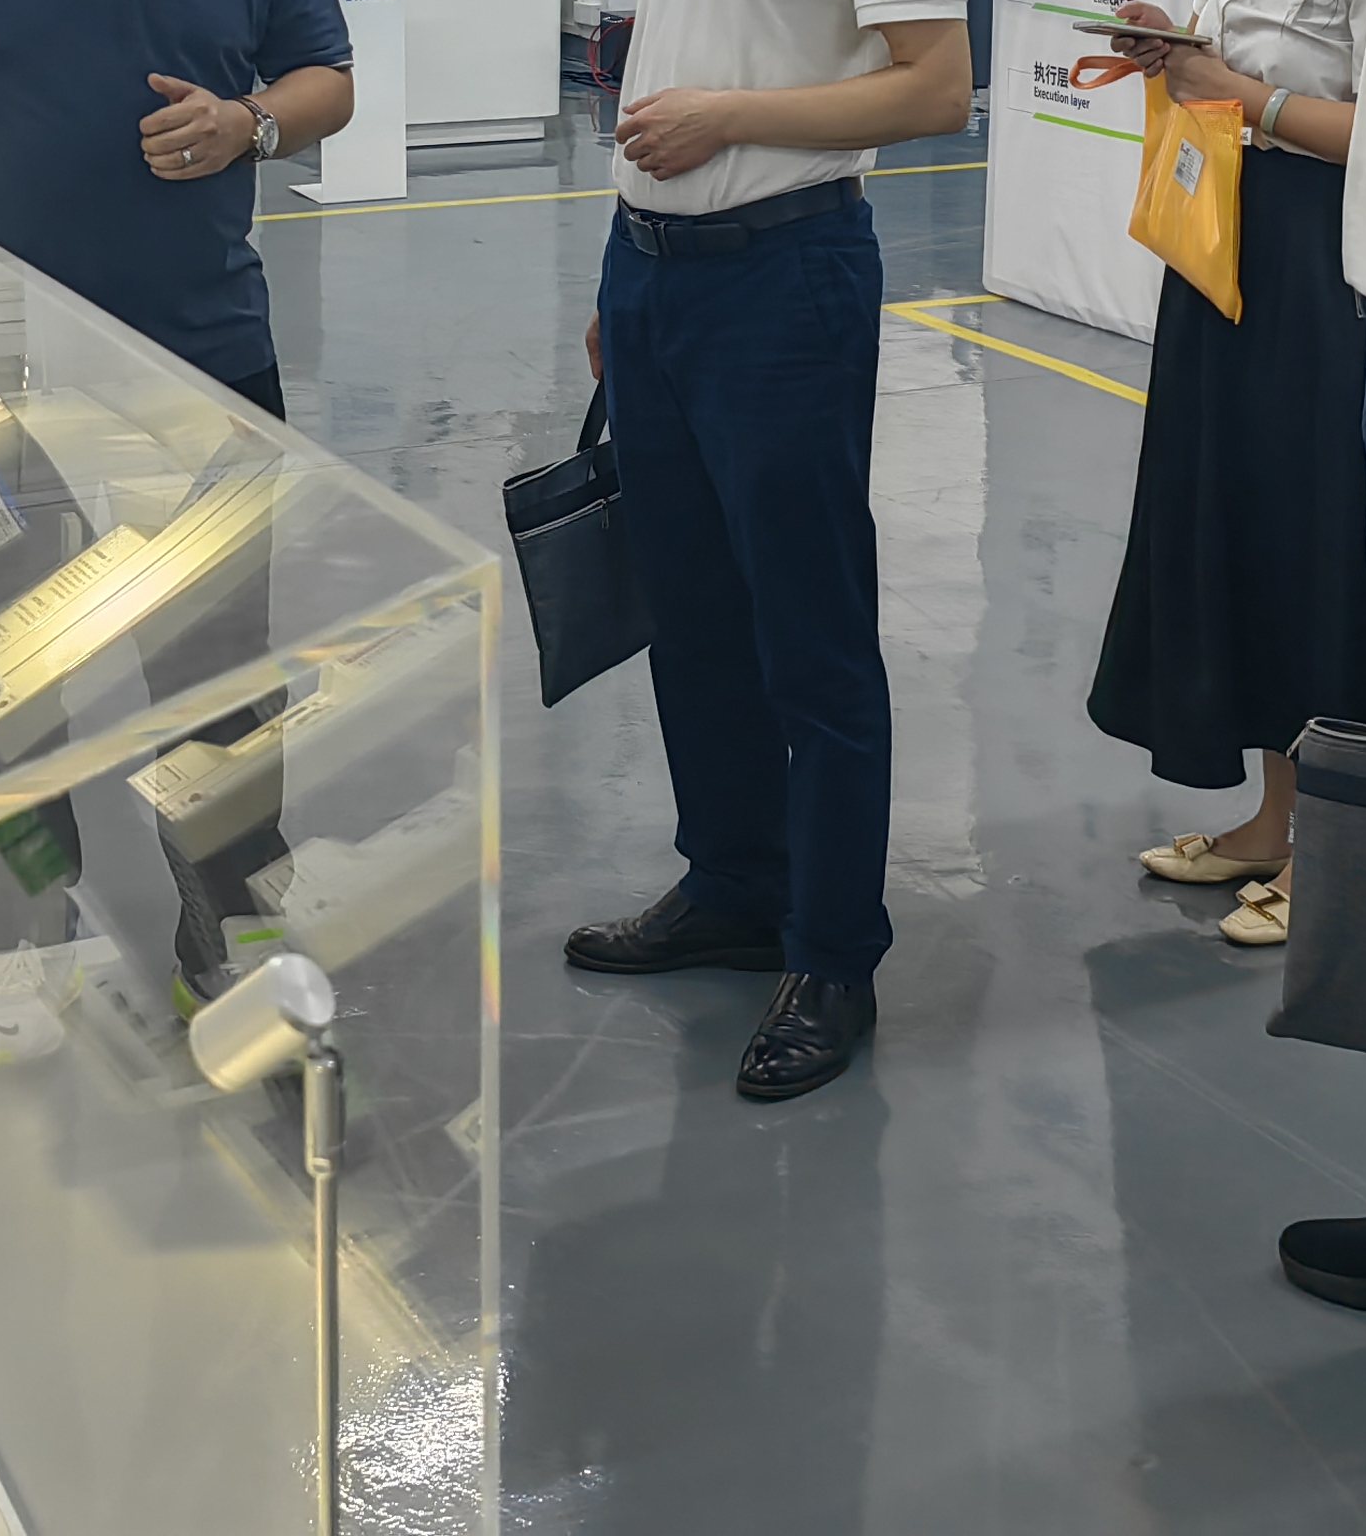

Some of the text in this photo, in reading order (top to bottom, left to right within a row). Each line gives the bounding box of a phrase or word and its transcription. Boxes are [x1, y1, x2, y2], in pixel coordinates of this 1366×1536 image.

[1034, 61, 1069, 89] 执行层
[1033, 85, 1090, 110] Execution layer
